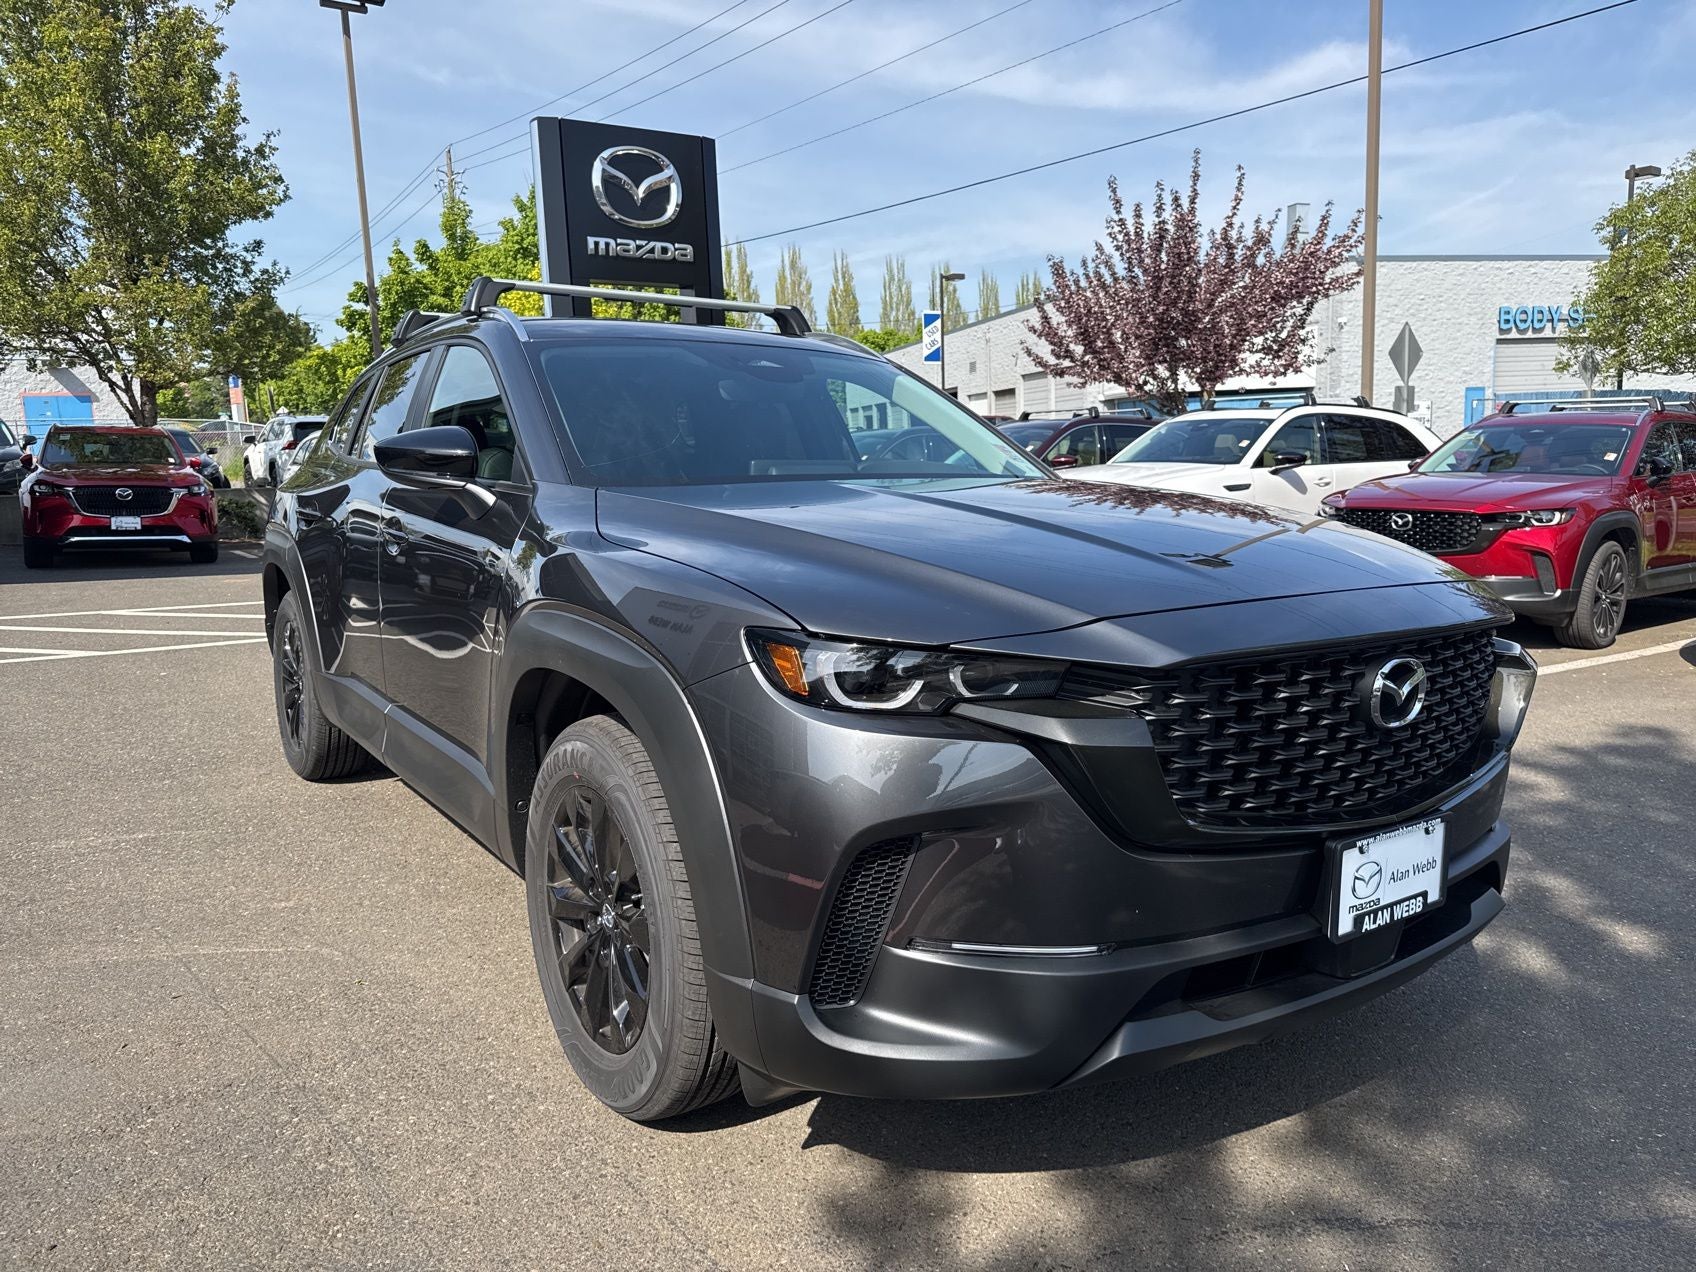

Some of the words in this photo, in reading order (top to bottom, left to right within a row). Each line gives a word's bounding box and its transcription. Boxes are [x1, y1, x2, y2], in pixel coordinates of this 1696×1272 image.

[587, 236, 694, 262] mazda
[1499, 305, 1563, 330] BODY
[926, 325, 939, 338] USED
[926, 338, 939, 350] CARS
[1388, 868, 1410, 885] Alan
[1412, 857, 1438, 876] Webb
[1348, 898, 1380, 914] mazda
[1362, 907, 1391, 932] ALAN
[1393, 897, 1423, 920] WEBB
